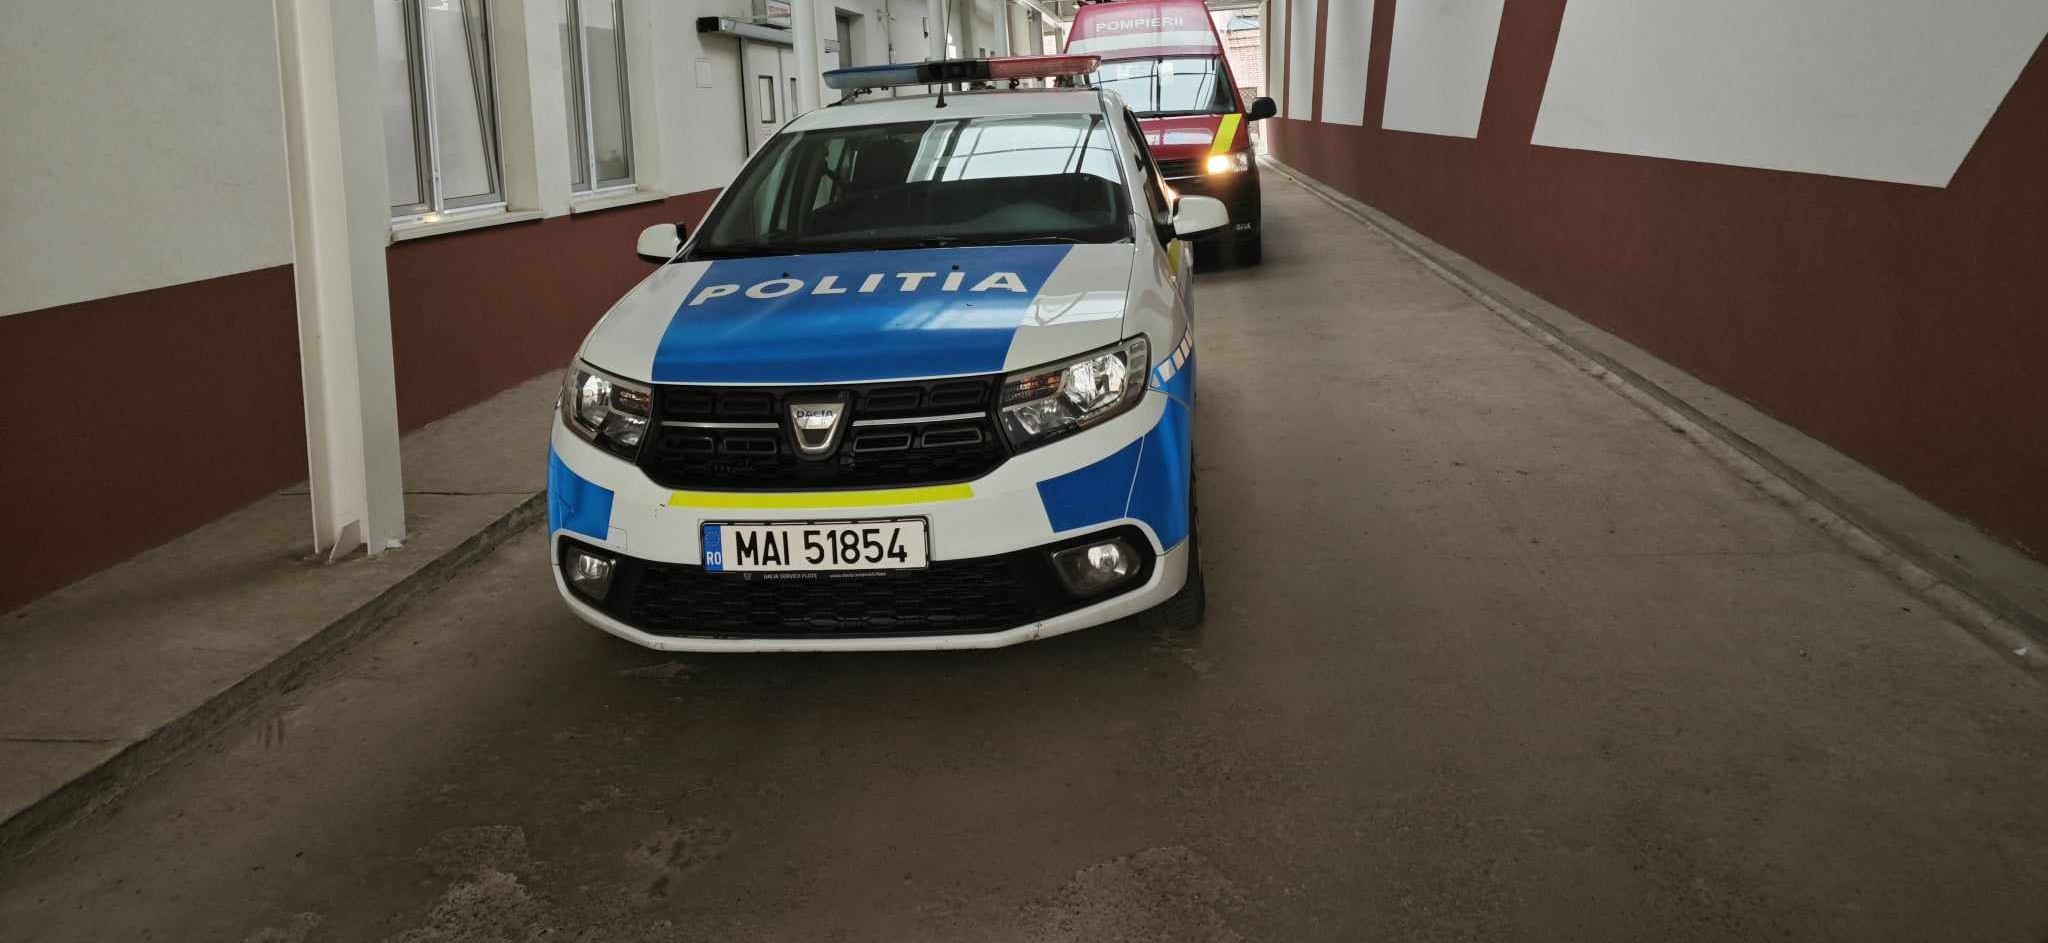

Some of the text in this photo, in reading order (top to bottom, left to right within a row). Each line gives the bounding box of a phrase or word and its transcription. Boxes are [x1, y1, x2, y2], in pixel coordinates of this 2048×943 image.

[1095, 17, 1184, 32] POMPIERII
[688, 271, 1028, 306] POLITIA
[706, 551, 722, 566] RO
[735, 527, 908, 566] MAI 51854
